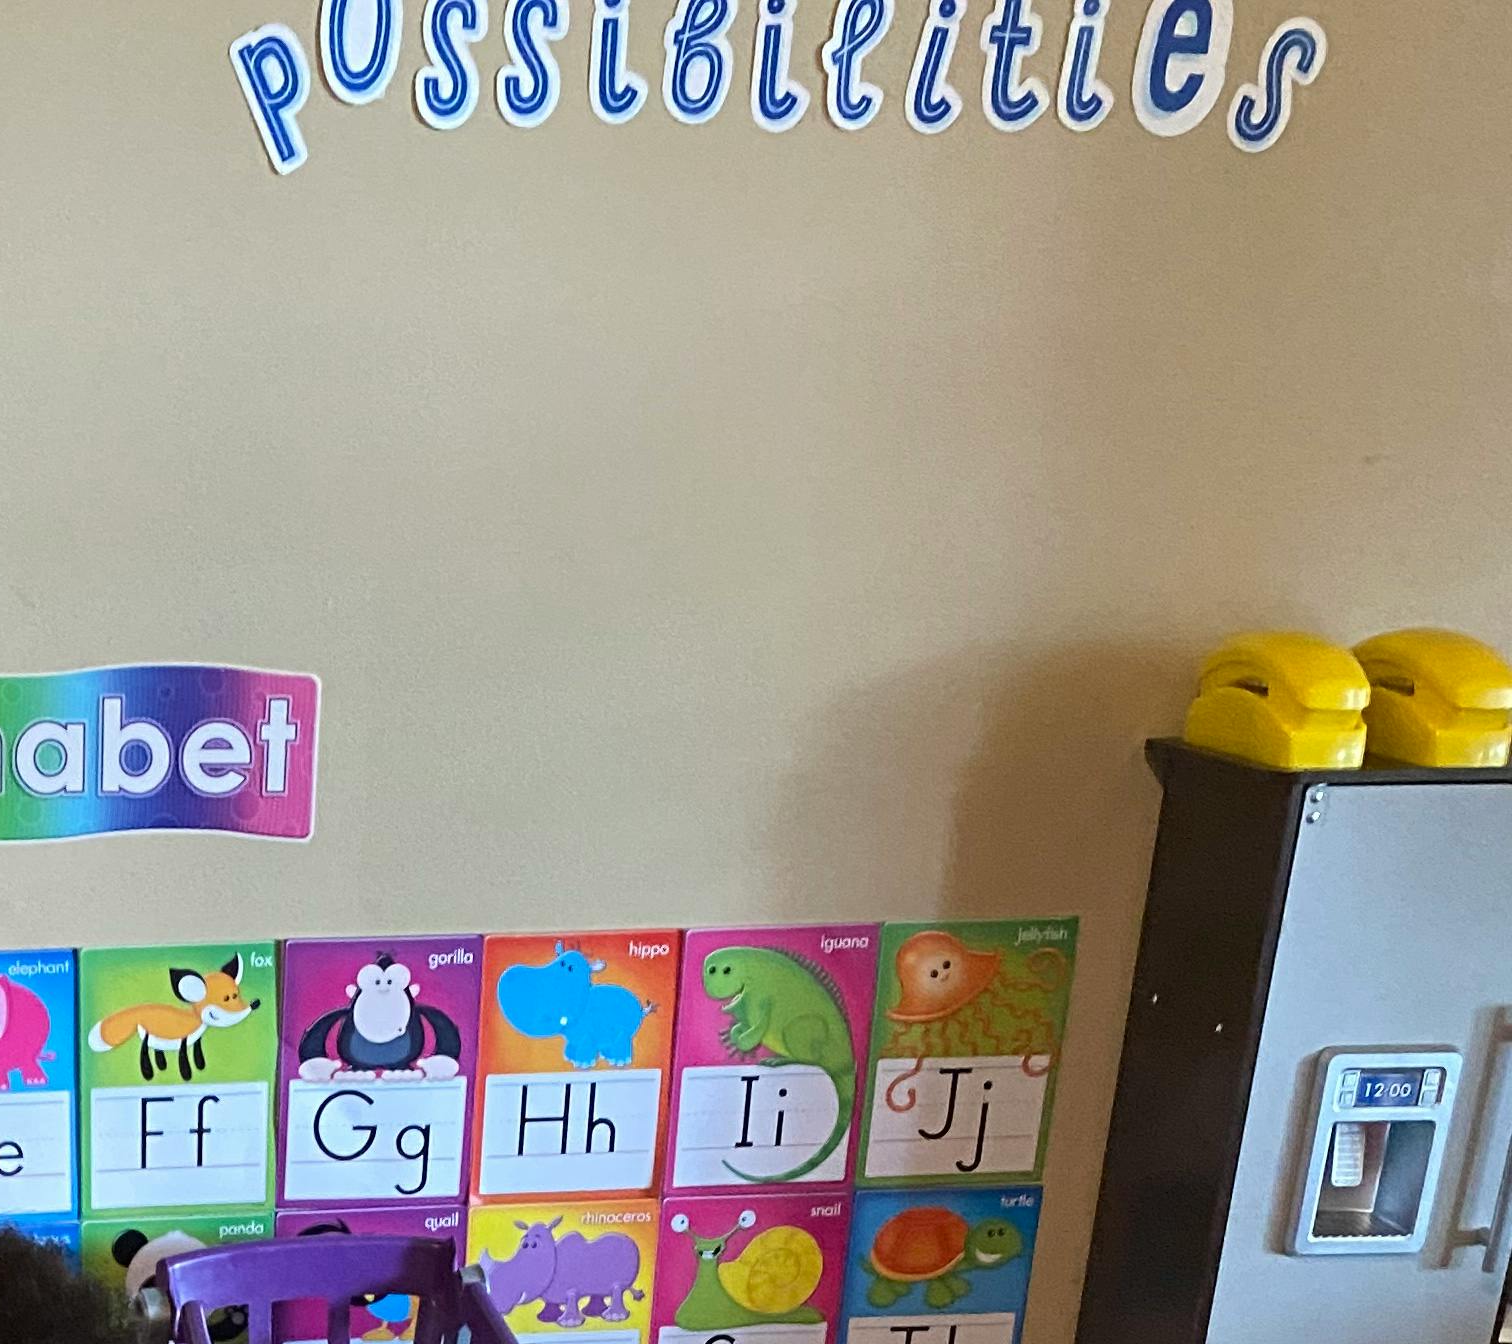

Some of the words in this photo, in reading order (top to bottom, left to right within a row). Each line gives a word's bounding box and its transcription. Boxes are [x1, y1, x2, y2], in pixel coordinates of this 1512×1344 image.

[820, 934, 869, 952] iguana
[1015, 925, 1068, 945] jellyfish
[628, 941, 669, 958] hippo
[7, 959, 70, 979] elephant
[250, 952, 273, 969] fox
[428, 949, 474, 970] gorilla
[518, 1083, 616, 1156] Hh
[735, 1075, 788, 1148] Ii
[918, 1068, 994, 1172] Jj
[141, 1096, 219, 1169] Ff
[313, 1090, 431, 1195] Gg
[810, 1203, 842, 1218] snail
[1000, 1195, 1034, 1209] turtle
[424, 1213, 459, 1232] quail
[580, 1210, 652, 1227] rhinoceros
[218, 1222, 265, 1239] panda
